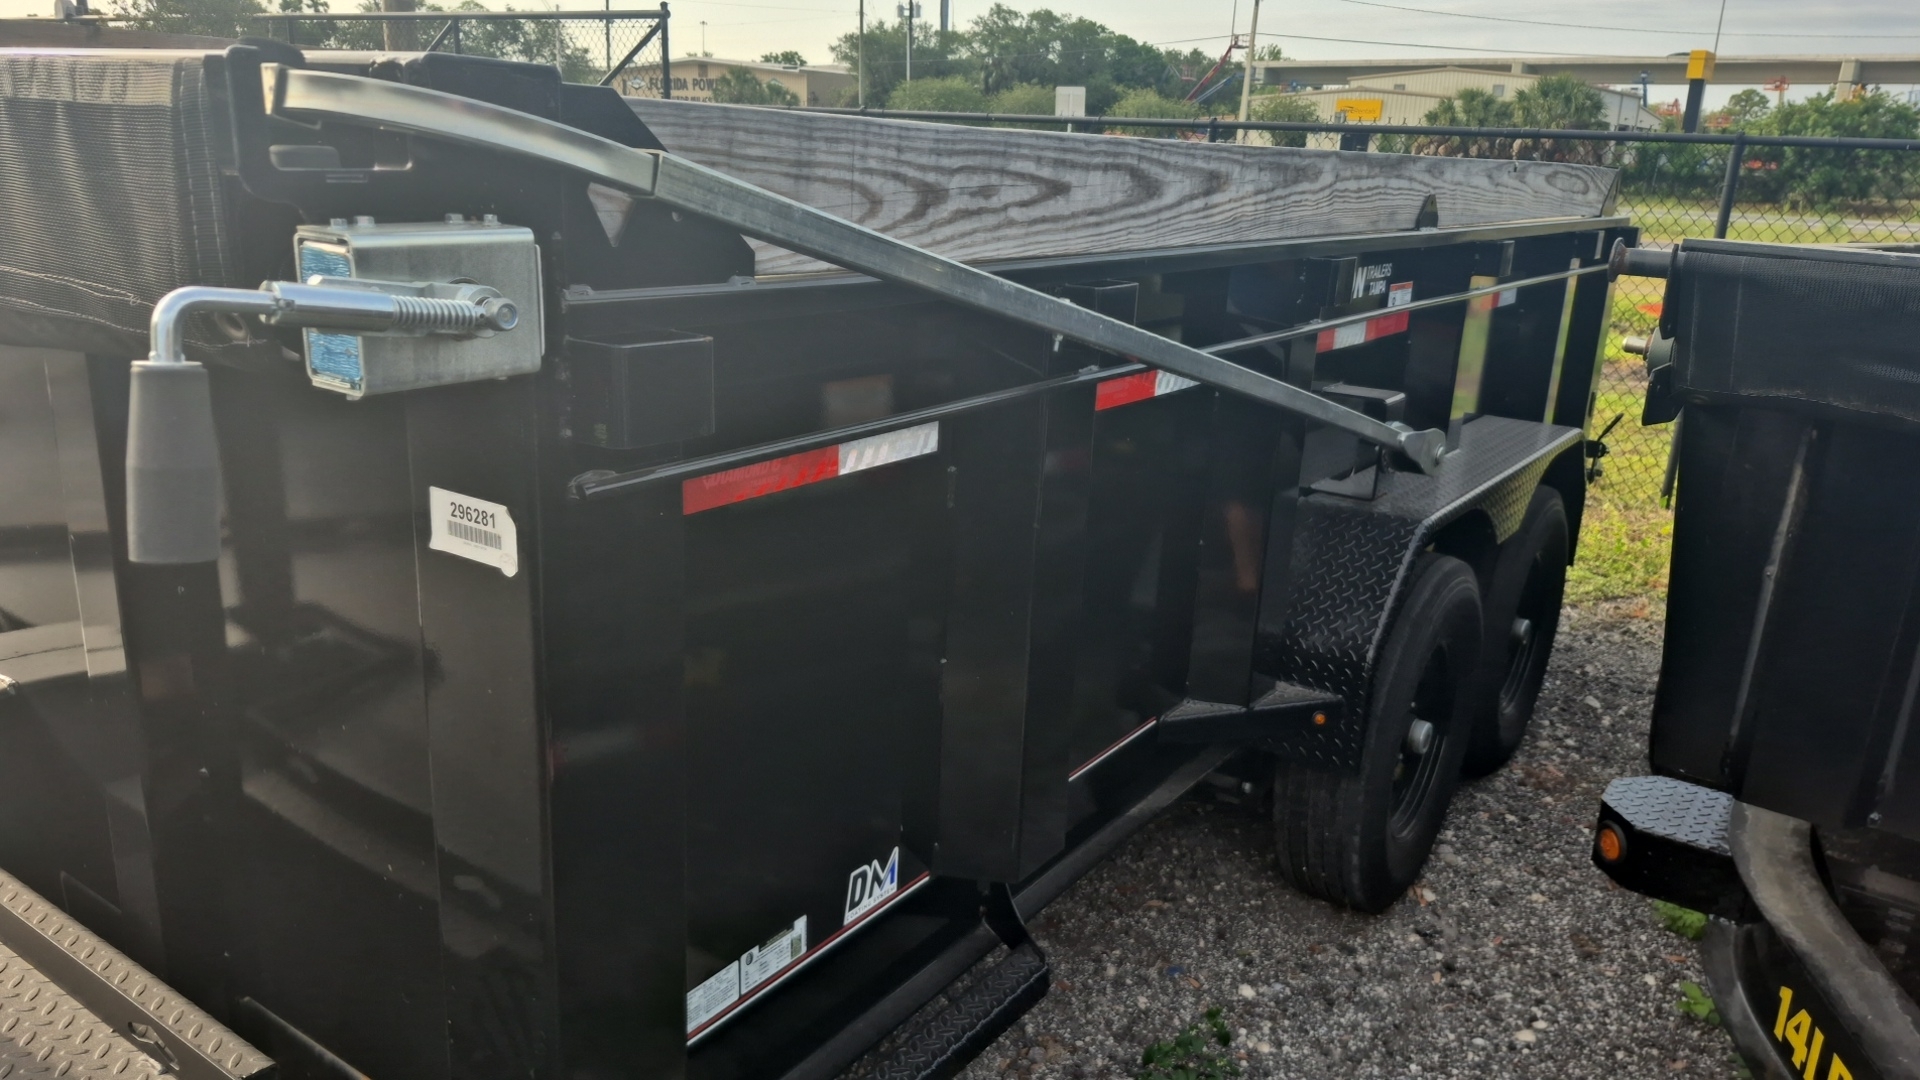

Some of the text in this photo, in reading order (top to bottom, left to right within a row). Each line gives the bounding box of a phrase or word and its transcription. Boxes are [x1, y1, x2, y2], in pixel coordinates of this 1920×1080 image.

[649, 77, 689, 91] FLIDA
[1367, 263, 1393, 279] TRAILERS
[1369, 280, 1387, 296] TAMPA
[450, 502, 496, 529] 296281
[846, 884, 897, 922] COATING SYSTEM
